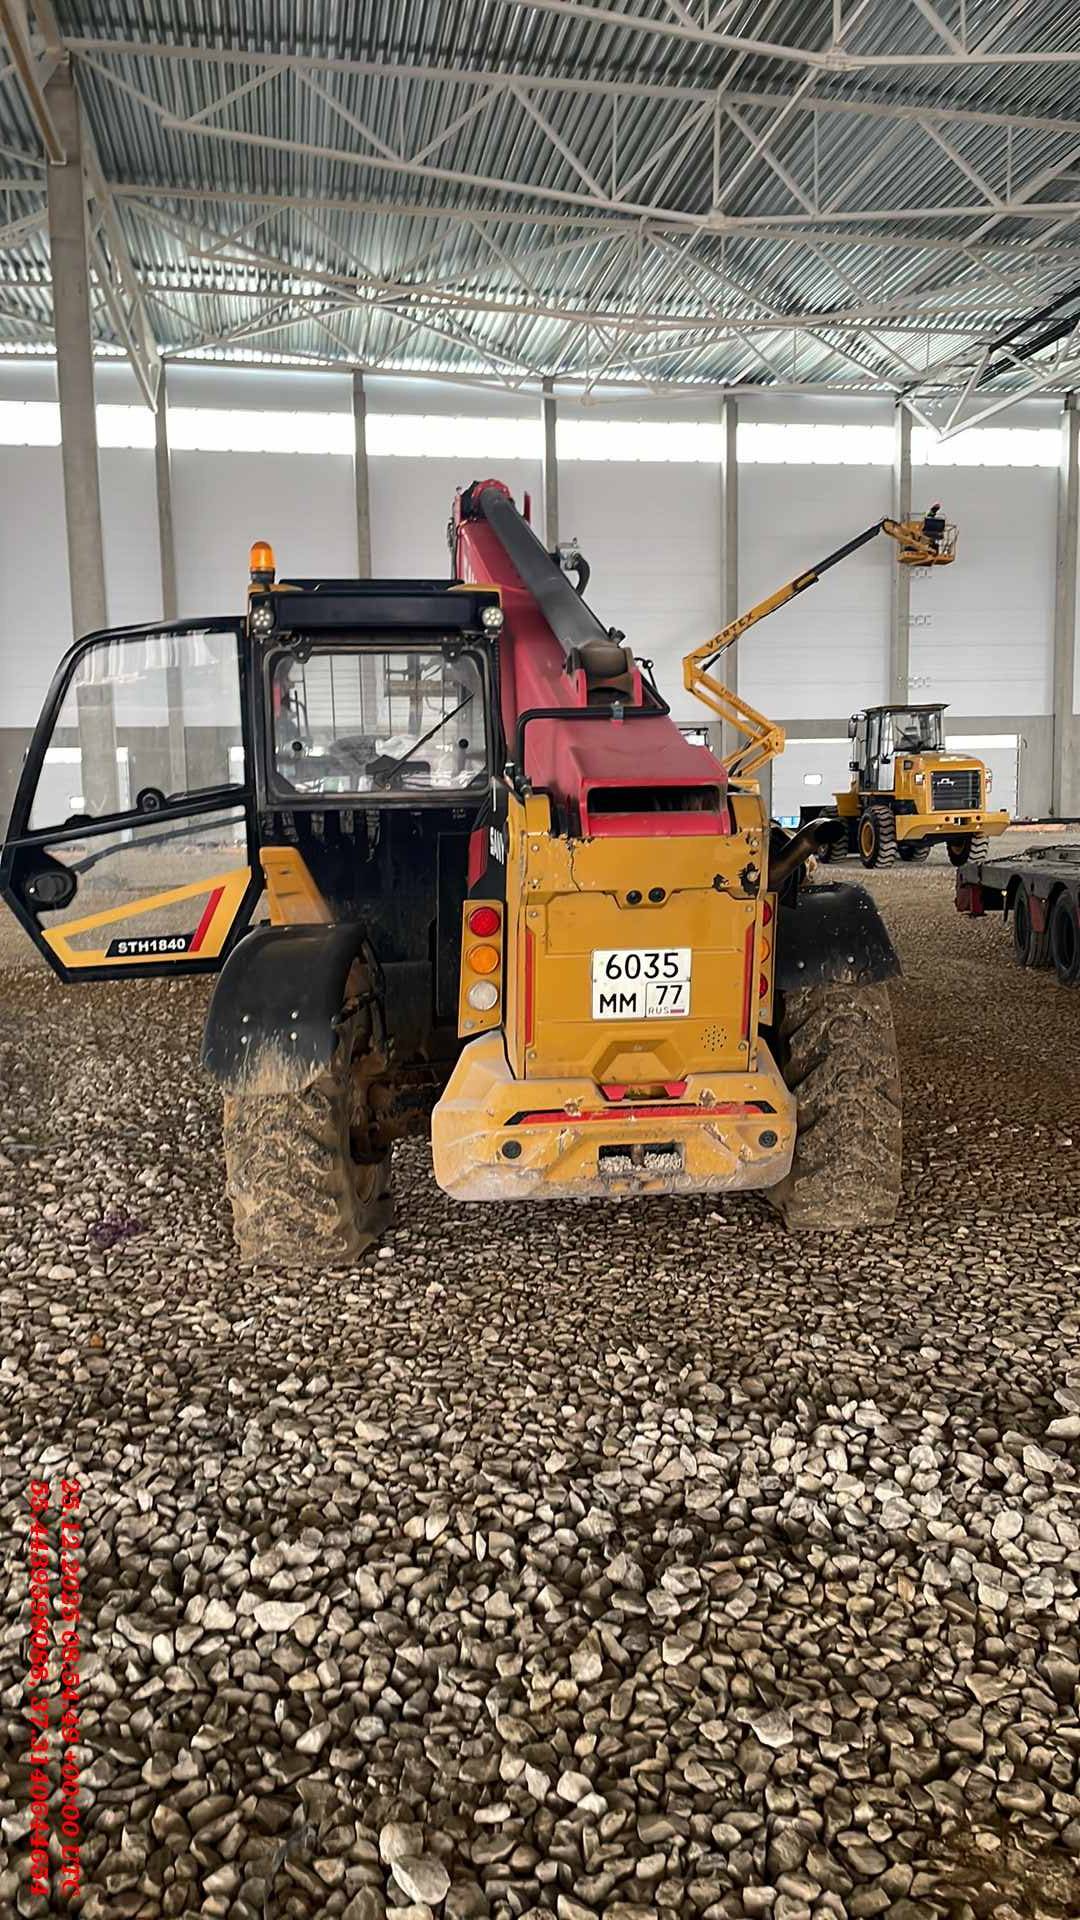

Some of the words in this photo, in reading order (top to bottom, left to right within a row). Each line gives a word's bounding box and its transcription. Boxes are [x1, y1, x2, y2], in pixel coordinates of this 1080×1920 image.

[706, 612, 753, 649] VERTEX
[118, 938, 185, 953] STH1840
[605, 952, 679, 979] 6035
[656, 985, 683, 1005] 77
[648, 1006, 670, 1015] RUS
